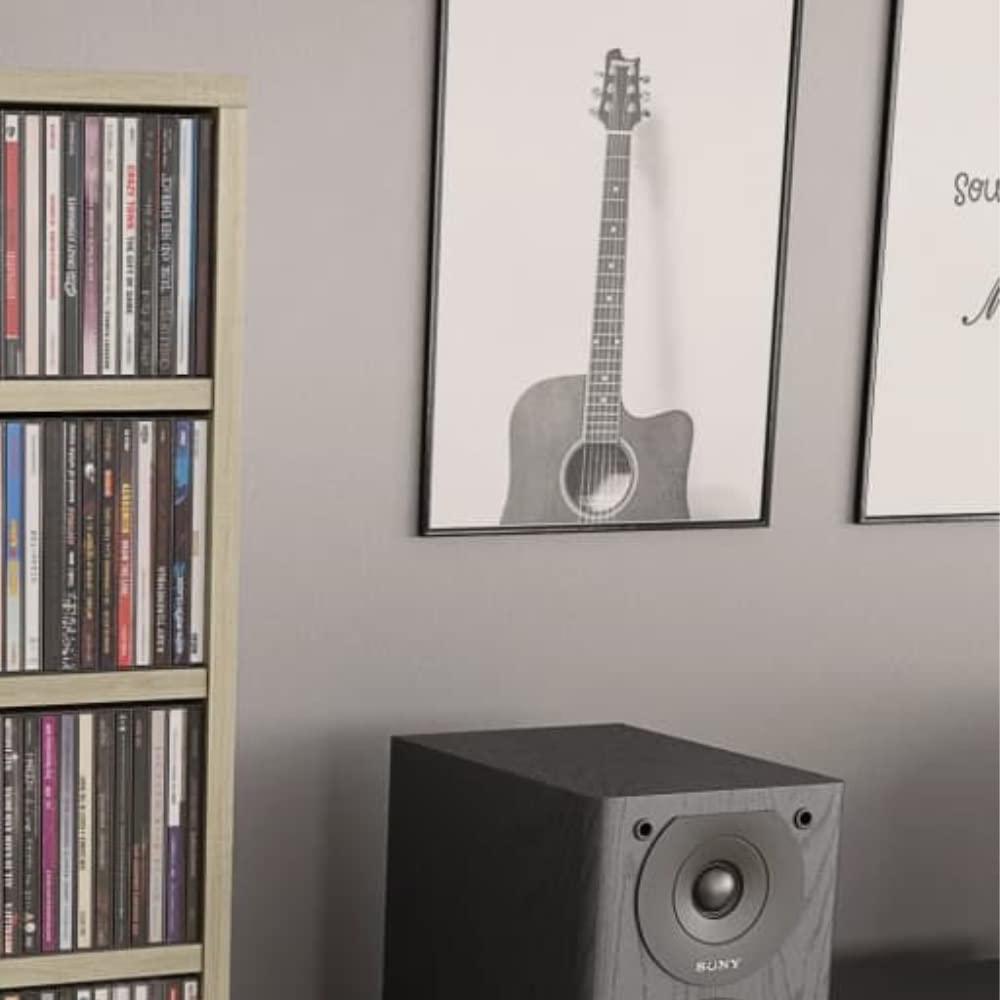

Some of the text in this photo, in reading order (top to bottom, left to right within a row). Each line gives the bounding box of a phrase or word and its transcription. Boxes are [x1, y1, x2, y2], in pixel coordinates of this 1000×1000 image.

[126, 164, 137, 198] CRAZY
[126, 201, 137, 231] TOWN
[126, 236, 137, 248] THE
